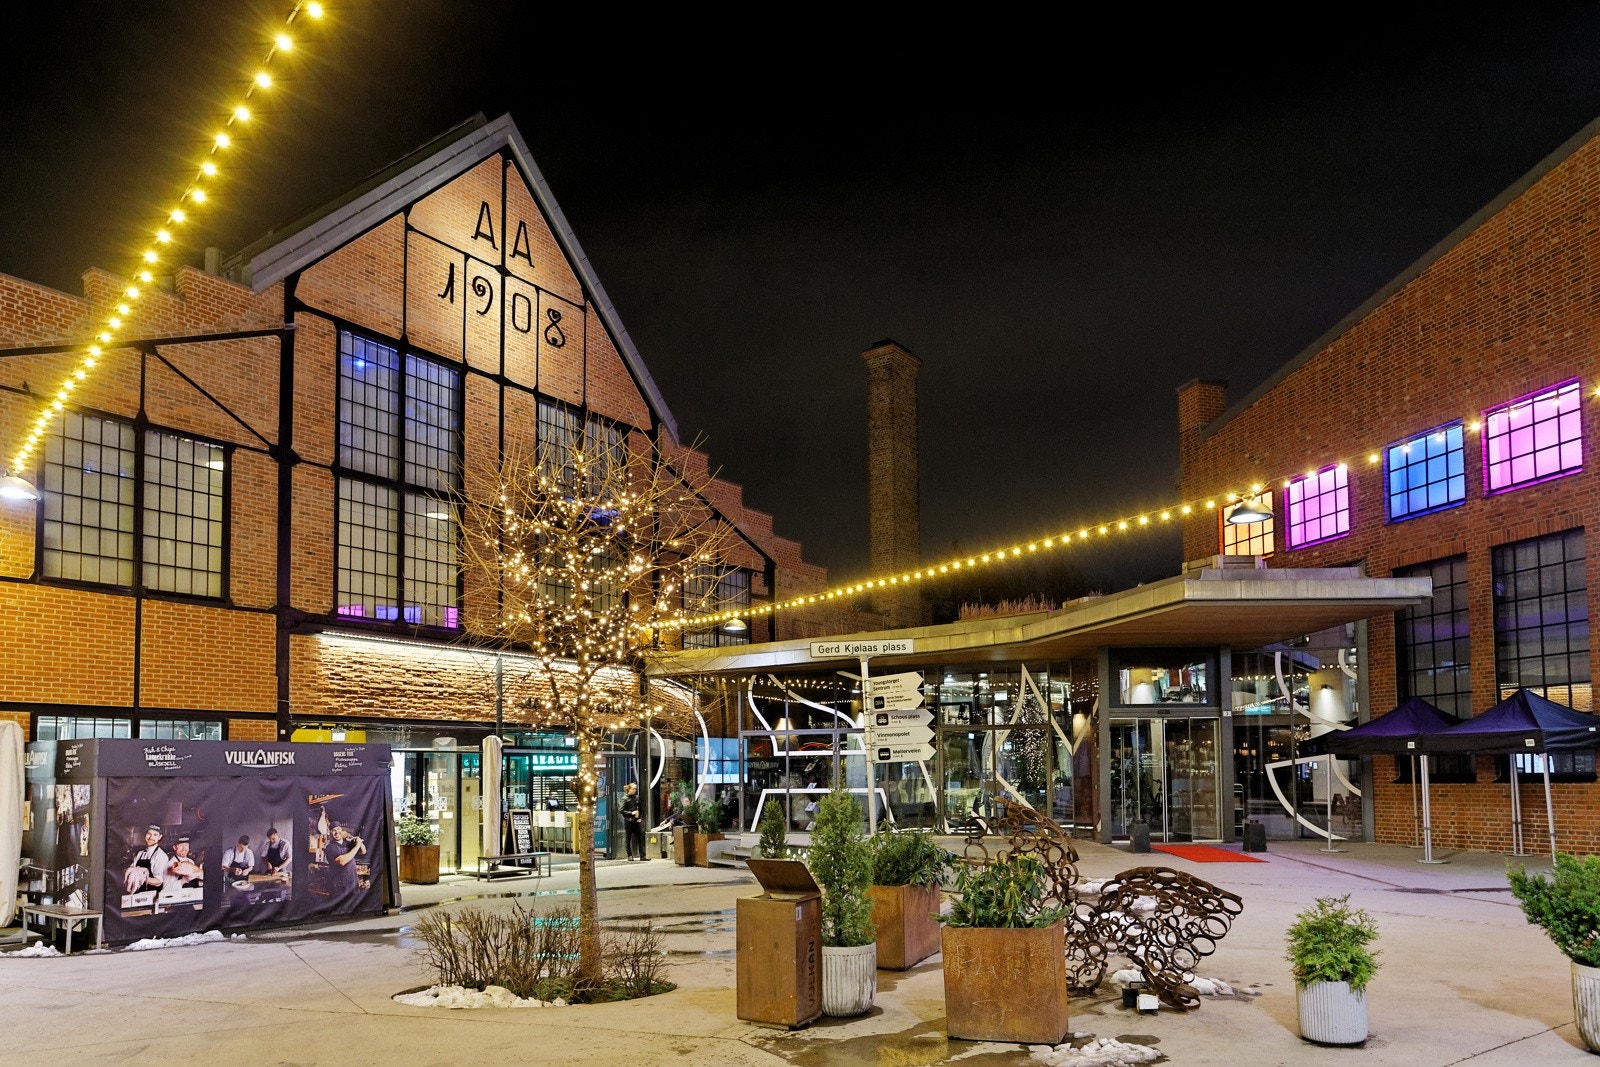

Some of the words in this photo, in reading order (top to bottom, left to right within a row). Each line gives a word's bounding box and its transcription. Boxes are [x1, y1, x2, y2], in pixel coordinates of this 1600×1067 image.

[471, 201, 498, 250] A
[509, 220, 535, 268] A
[438, 262, 566, 348] 1908
[818, 645, 840, 654] Gerd
[844, 643, 878, 654] Kjølaas
[883, 642, 907, 652] plass
[873, 678, 900, 686] Youngstorget
[225, 749, 295, 765] VULKANFISK
